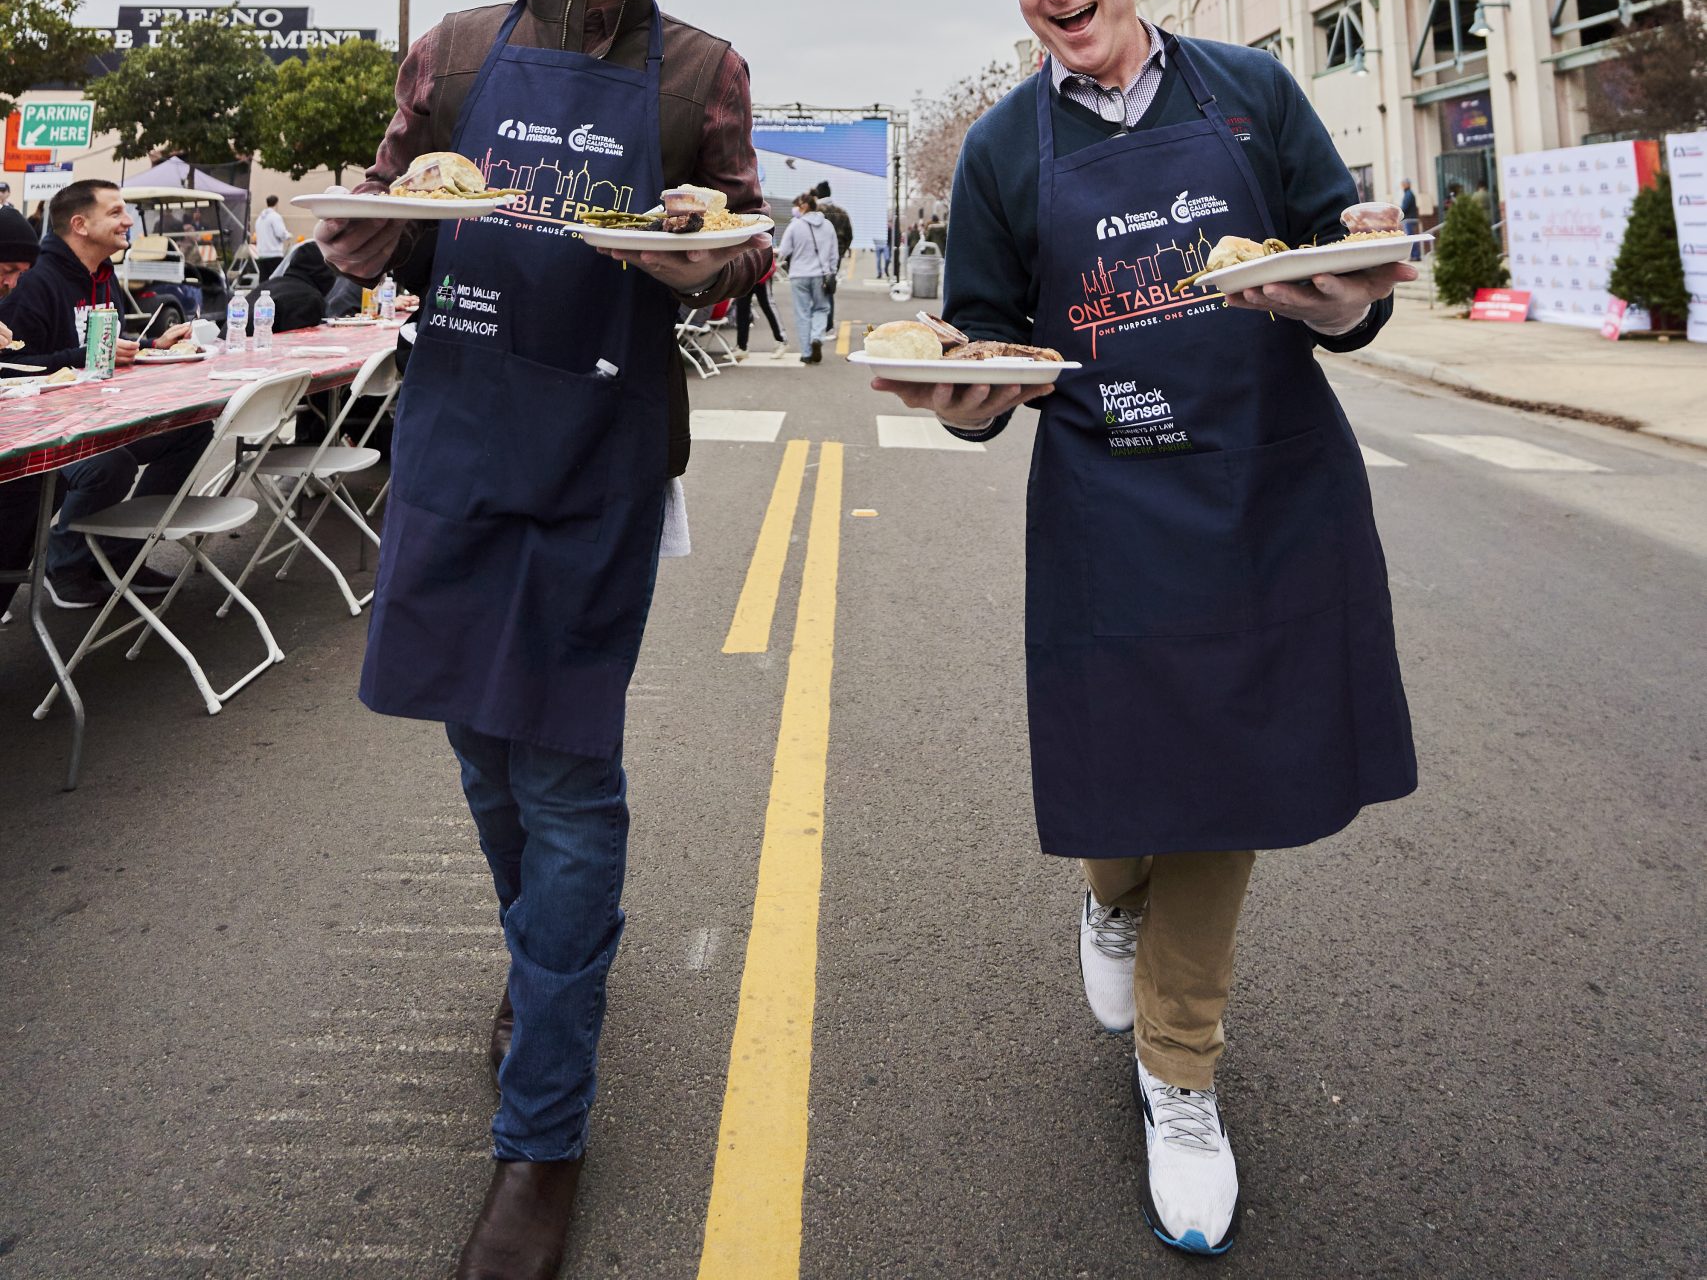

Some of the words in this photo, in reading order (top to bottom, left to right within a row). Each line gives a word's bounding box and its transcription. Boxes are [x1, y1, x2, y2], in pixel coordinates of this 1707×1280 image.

[26, 106, 88, 121] PARKING
[49, 126, 86, 141] HERE
[528, 123, 557, 135] fresno
[526, 133, 563, 145] mission
[586, 140, 624, 150] CALIFORNIA
[587, 134, 616, 144] CENTRAL
[585, 145, 605, 154] FOOD
[605, 148, 624, 156] BANK
[1187, 195, 1217, 207] CENTRAL
[1189, 200, 1227, 212] CALIFORNIA
[1125, 210, 1158, 224] fresno
[1191, 210, 1211, 219] FOOD
[1211, 205, 1229, 215] BANK
[515, 222, 533, 231] ONE
[536, 225, 568, 237] CAUSE.
[1127, 217, 1168, 233] mission
[457, 284, 471, 296] MID
[472, 286, 501, 301] VALLEY
[459, 297, 498, 314] DISPOSAL
[1068, 297, 1116, 324] ONE
[429, 314, 447, 327] JOE
[448, 316, 499, 337] KALPAKOFF
[1098, 327, 1116, 337] ONE
[1118, 317, 1162, 332] PURPOSE.
[1164, 311, 1184, 321] ONE
[1187, 303, 1220, 316] CAUSE.
[1099, 380, 1137, 397] Baker
[1103, 387, 1165, 412] Manock
[1105, 410, 1117, 424] &
[1118, 402, 1172, 423] Jensen
[1158, 422, 1174, 431] LAW
[1108, 436, 1154, 448] KENNETH
[1155, 431, 1188, 445] PRICE
